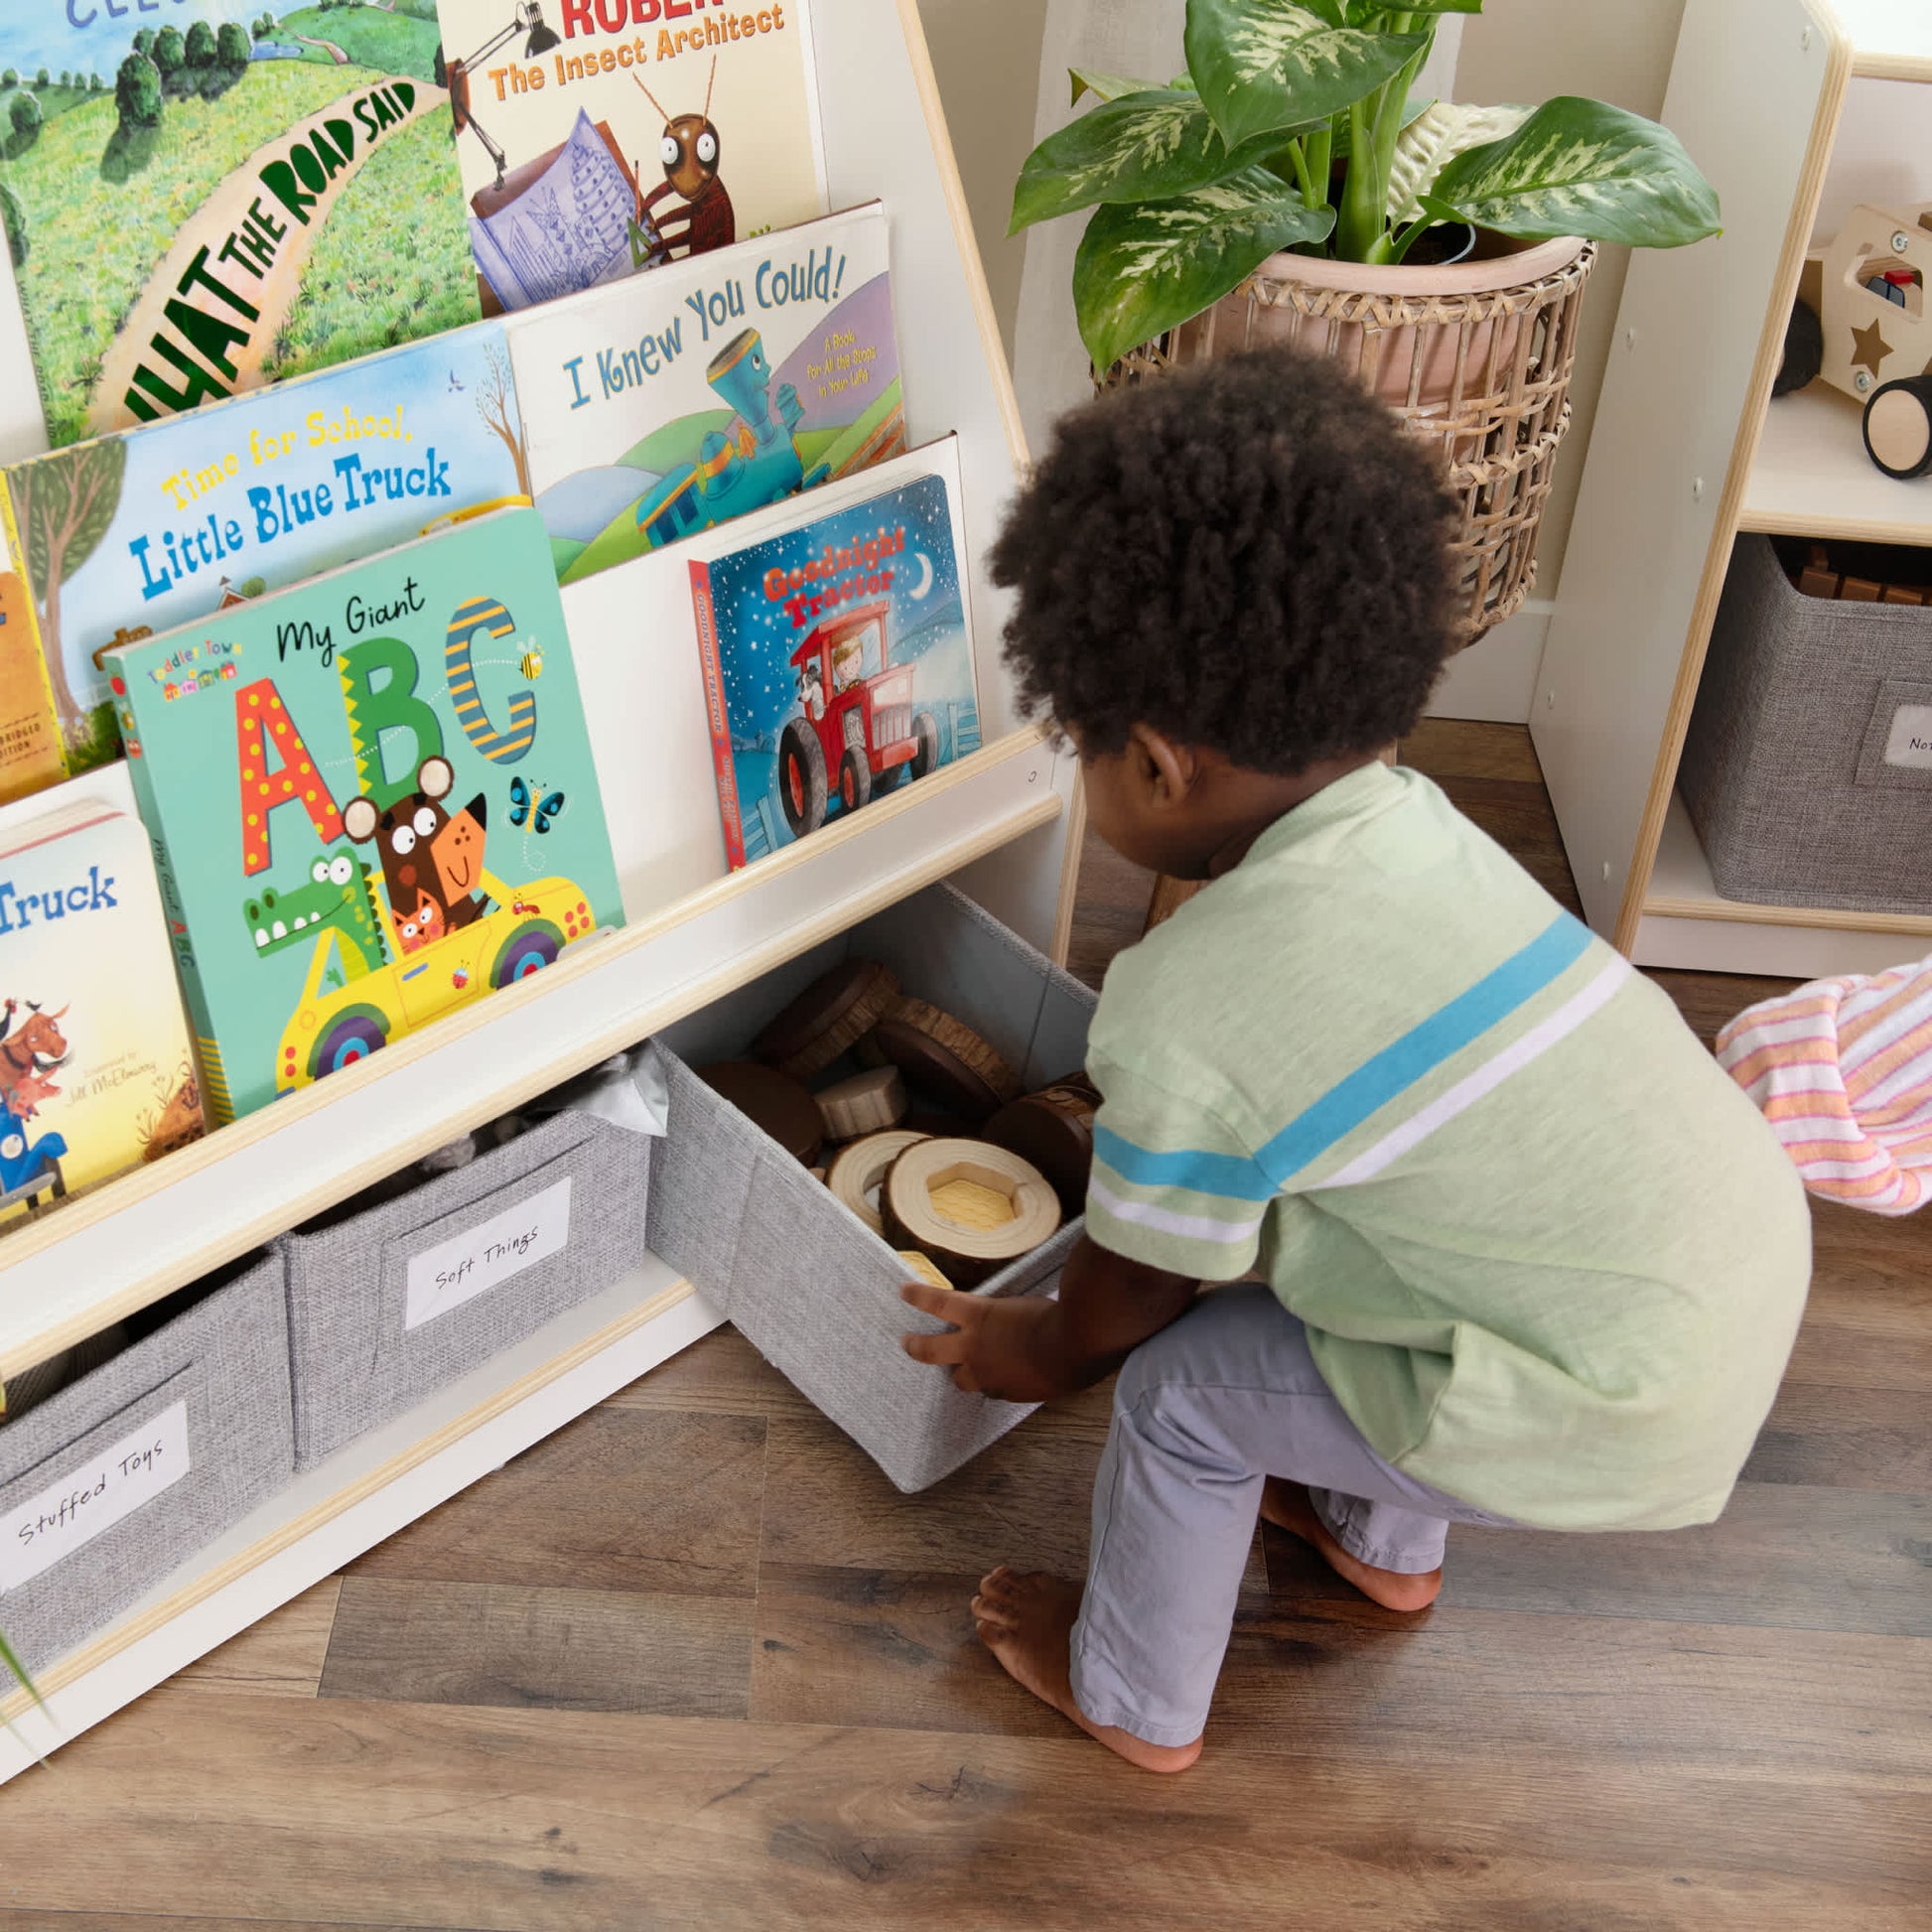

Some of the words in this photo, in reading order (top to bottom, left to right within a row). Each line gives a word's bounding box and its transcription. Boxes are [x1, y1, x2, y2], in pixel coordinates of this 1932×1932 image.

[487, 64, 545, 101] The
[555, 38, 647, 86] Insect
[656, 3, 785, 62] Architect
[217, 197, 288, 281] THE
[259, 118, 355, 227] ROAD
[352, 82, 416, 144] SAID
[562, 355, 591, 411] I
[597, 316, 683, 401] Knew
[685, 281, 747, 343] You
[755, 244, 848, 311] Could!
[824, 354, 835, 375] All
[825, 337, 831, 353] A
[833, 330, 855, 349] Book
[828, 378, 849, 396] Your
[850, 367, 870, 387] Life
[162, 459, 239, 511] Time
[249, 428, 297, 467] for
[129, 512, 244, 602] Little
[246, 483, 334, 532] Blue
[334, 447, 453, 512] Truck
[762, 526, 906, 603] Goodnight
[276, 621, 337, 668] My
[345, 576, 426, 635] Giant
[782, 572, 896, 629] Tractor
[697, 593, 715, 672] GOODNIGHT
[708, 673, 723, 733] TRACTOR
[234, 596, 537, 877] ABC
[1908, 738, 1932, 751] No
[435, 1256, 476, 1290] Soft
[483, 1224, 539, 1267] Things
[18, 1474, 106, 1545] Stuffed
[118, 1439, 164, 1483] Toys
